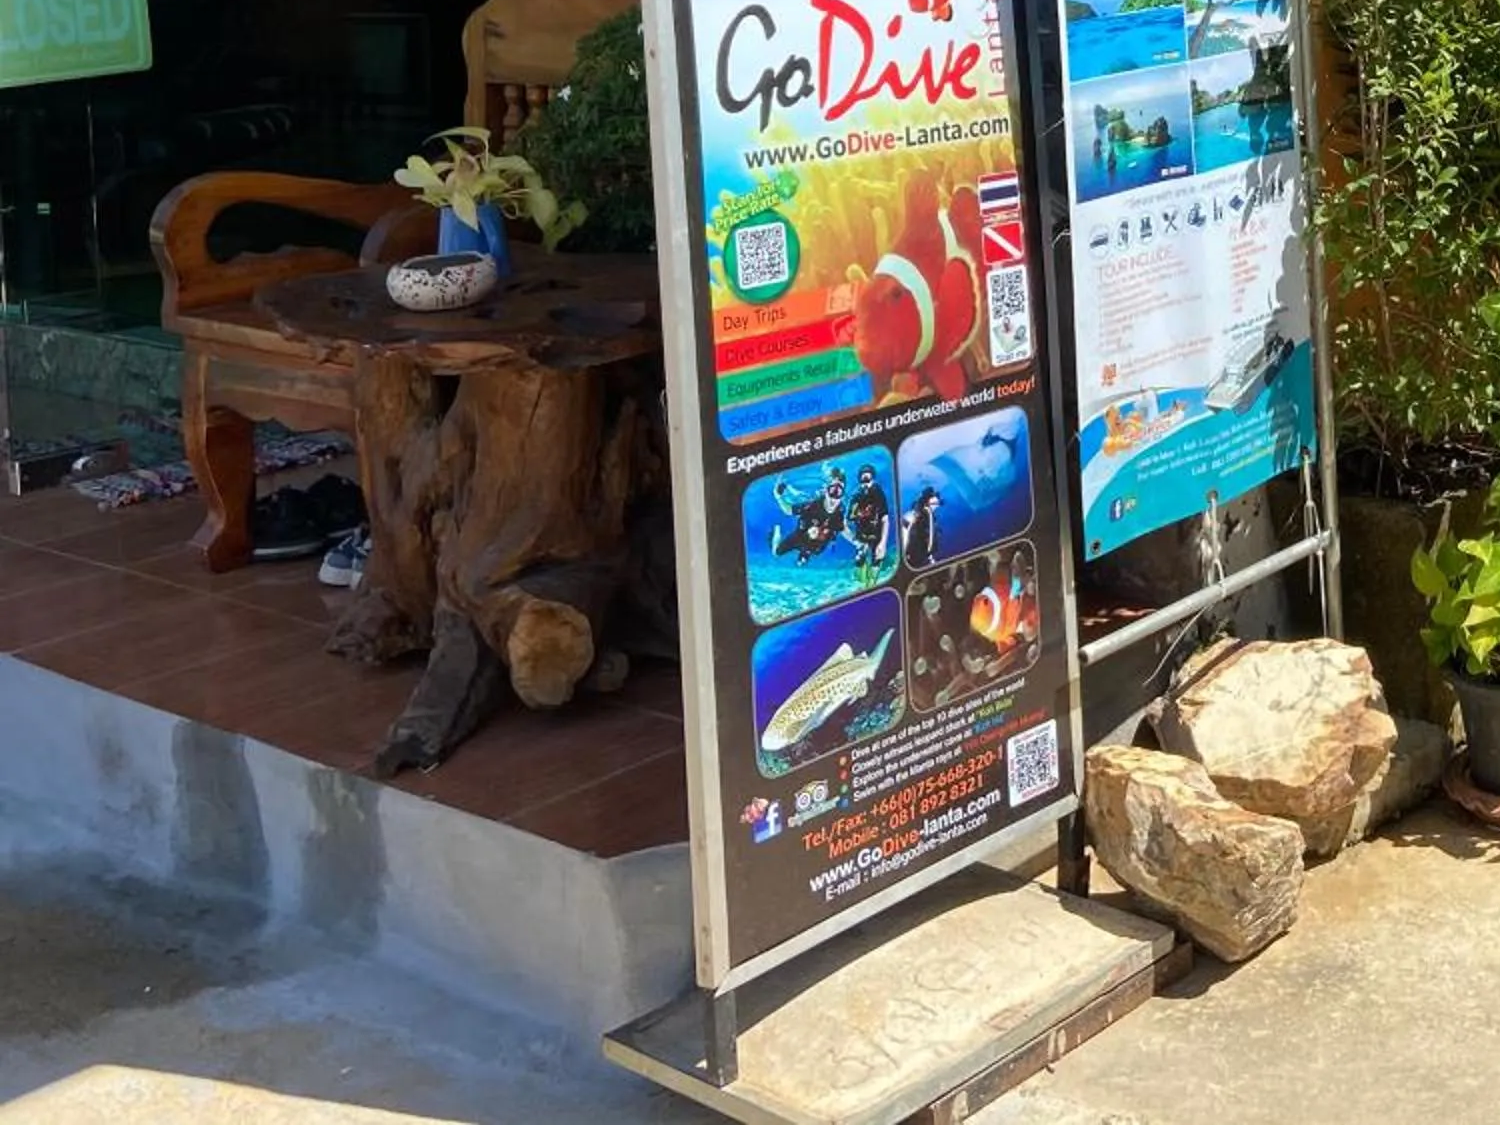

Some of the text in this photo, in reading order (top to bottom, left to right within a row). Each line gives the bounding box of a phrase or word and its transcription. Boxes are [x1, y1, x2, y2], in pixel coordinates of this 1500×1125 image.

[745, 116, 1010, 170] www.GoDive-Lanta.com
[723, 307, 788, 331] Day Trips
[758, 334, 810, 355] Courses
[727, 375, 1035, 474] Experience a fabulous underwater world today!
[829, 826, 880, 859] Mobile
[889, 804, 915, 829] 081
[920, 790, 948, 815] 892
[949, 774, 983, 801] 8321
[825, 871, 861, 901] E-mail
